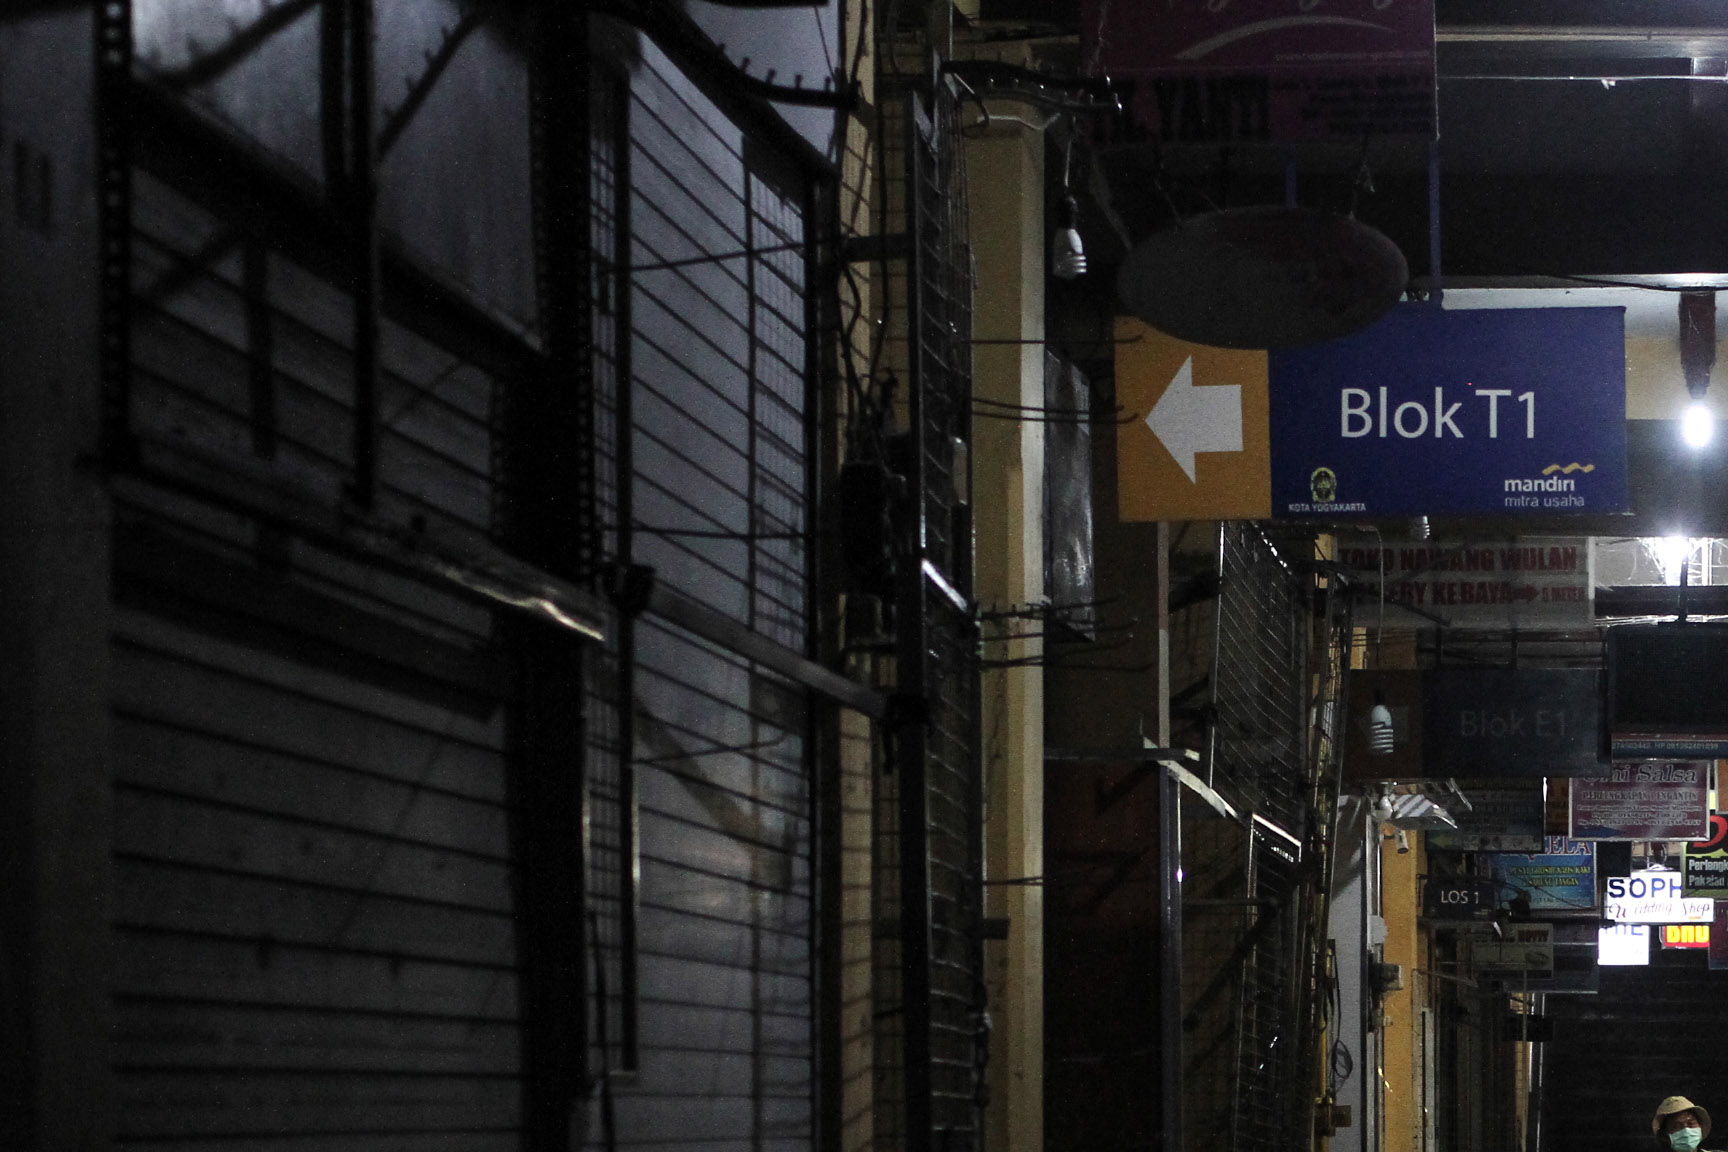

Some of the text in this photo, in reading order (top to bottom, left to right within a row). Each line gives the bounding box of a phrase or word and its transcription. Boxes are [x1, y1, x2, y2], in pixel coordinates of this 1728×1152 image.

[1341, 386, 1536, 439] Blok T1
[1504, 475, 1575, 492] mandiri
[1288, 503, 1367, 513] KOTA YOGYAKARTA
[1504, 494, 1585, 507] mitra usaha
[1500, 546, 1577, 571] WULAN
[1432, 581, 1513, 605] KEBAYA
[1460, 708, 1566, 738] Blok E1
[1636, 763, 1698, 784] Salsa
[1440, 890, 1480, 904] LOS 1
